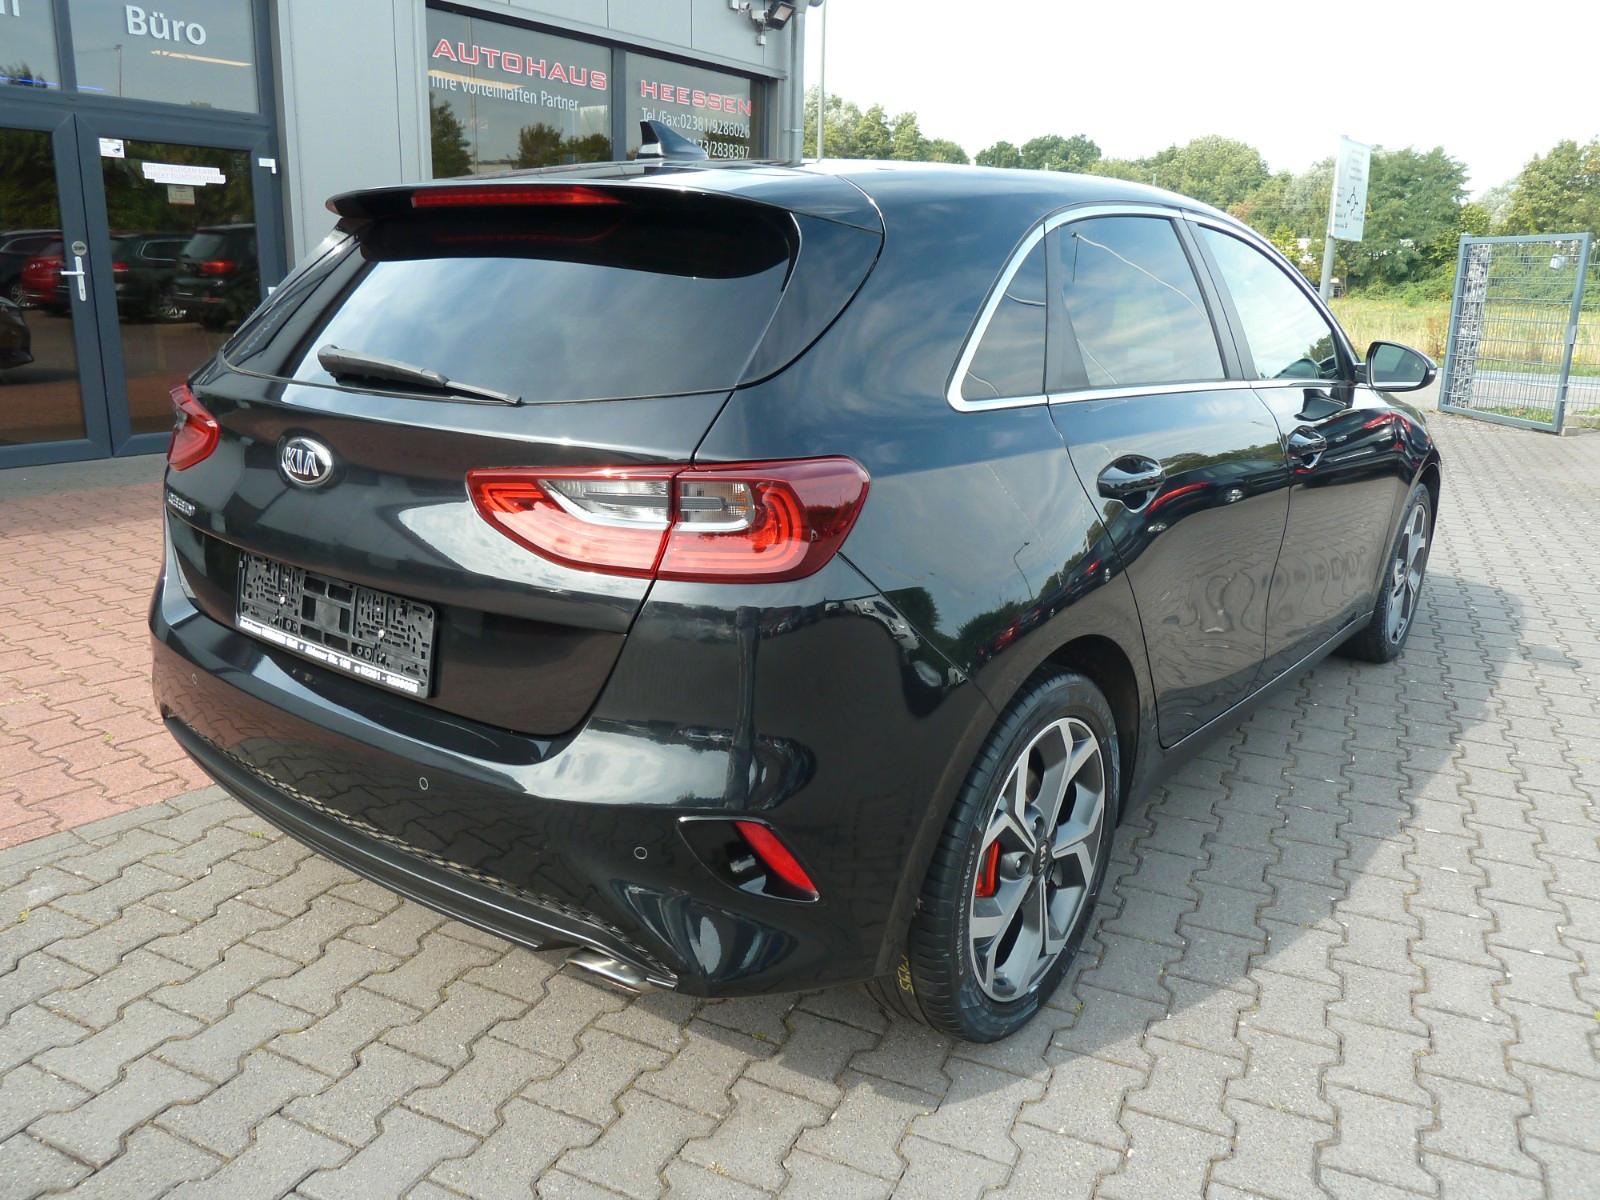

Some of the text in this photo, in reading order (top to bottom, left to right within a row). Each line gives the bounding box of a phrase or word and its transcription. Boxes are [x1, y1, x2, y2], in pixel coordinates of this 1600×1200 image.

[125, 4, 207, 46] Büro
[432, 38, 607, 91] AUTOHAUS
[541, 90, 579, 112] Partner
[641, 79, 752, 117] HEESSEN
[687, 137, 750, 160] 73/2838397
[285, 446, 319, 477] KIA
